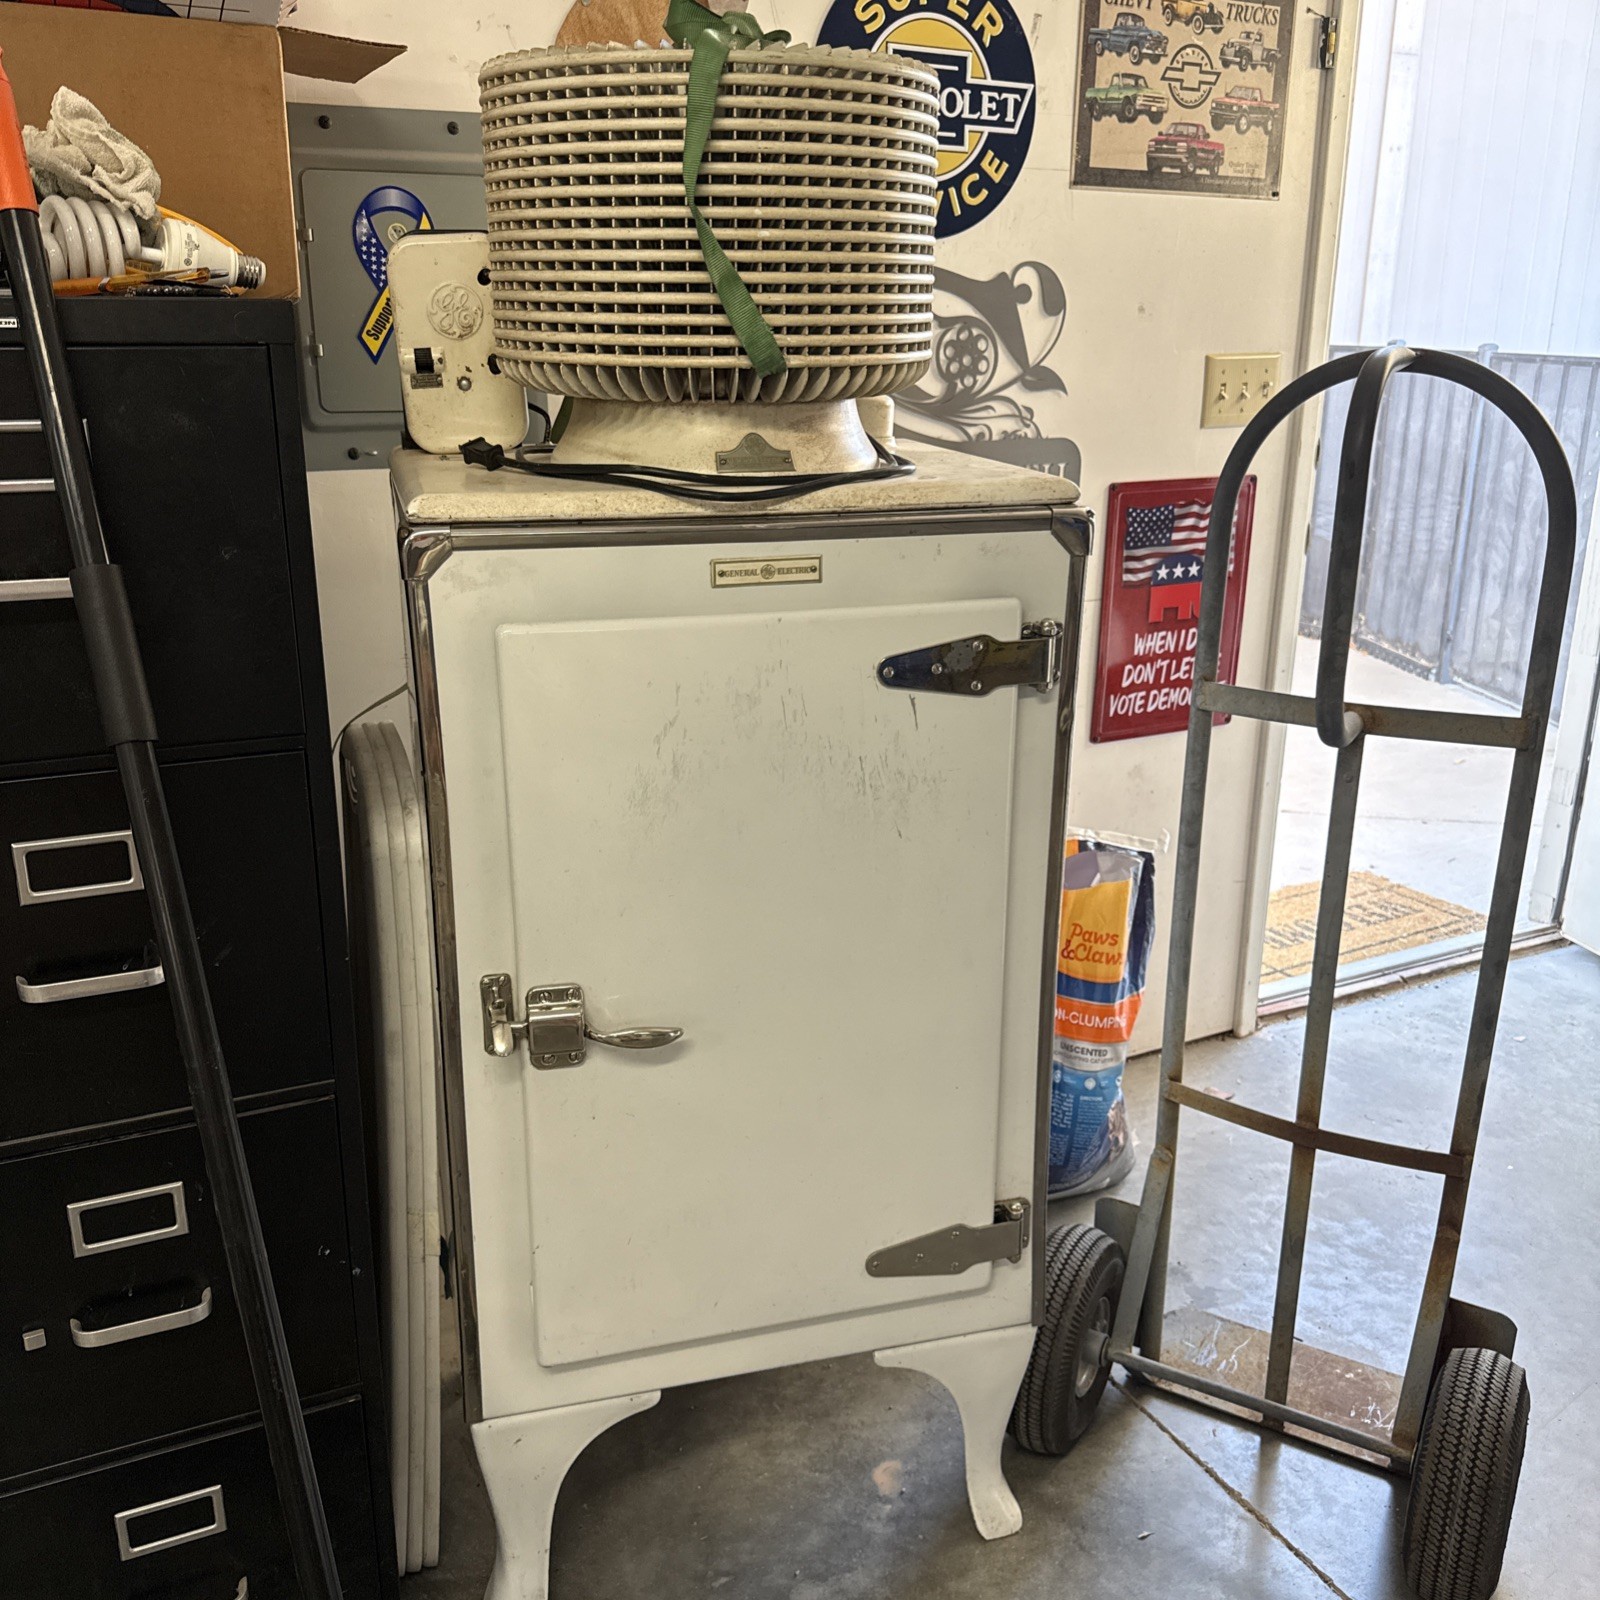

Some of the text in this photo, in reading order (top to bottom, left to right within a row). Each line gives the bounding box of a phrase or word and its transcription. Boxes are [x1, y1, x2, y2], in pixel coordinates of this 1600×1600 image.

[854, 0, 1004, 48] SER
[1226, 3, 1279, 26] TRUCKS
[938, 86, 1021, 122] OLET
[724, 568, 760, 578] GENERAL
[1134, 629, 1178, 657] WHEN
[1178, 629, 1187, 653] I
[1121, 658, 1170, 688] DON'T
[1109, 690, 1147, 718] VOTE
[1071, 922, 1120, 947] Paws
[1060, 1041, 1109, 1058] UNSCENTED
